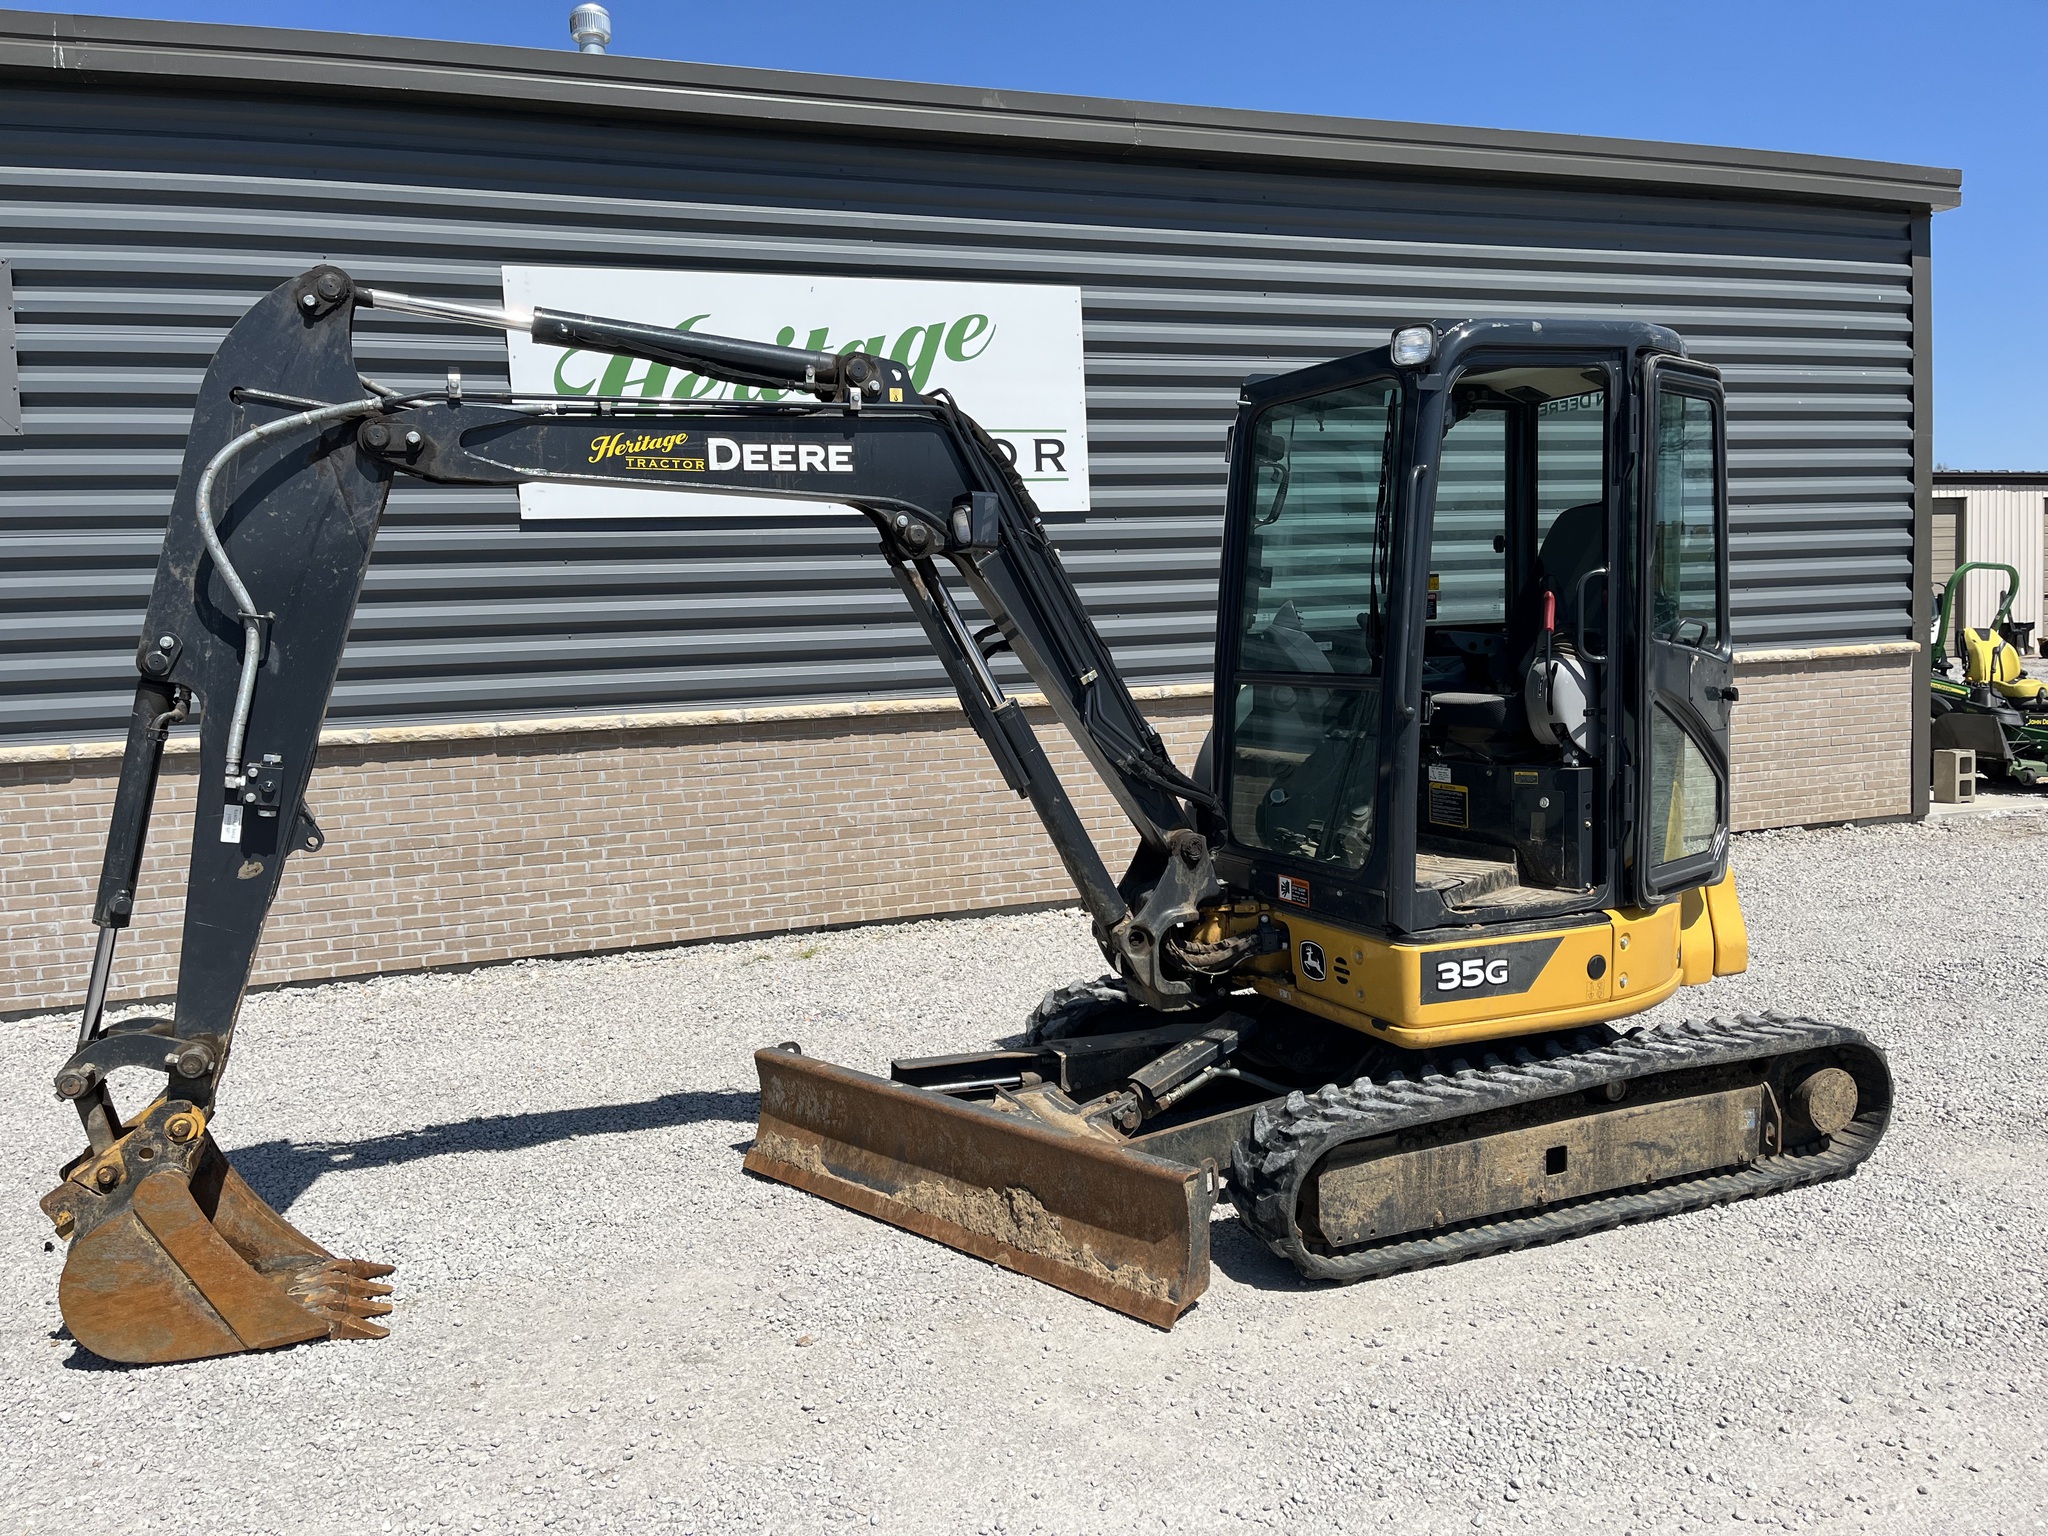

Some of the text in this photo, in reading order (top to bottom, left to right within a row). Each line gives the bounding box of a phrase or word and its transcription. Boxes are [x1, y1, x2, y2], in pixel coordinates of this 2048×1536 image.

[554, 313, 997, 416] Hitge
[588, 432, 688, 463] Heritage
[707, 437, 854, 472] DEERE
[626, 458, 705, 470] TRACTOR
[1437, 958, 1509, 990] 35G
